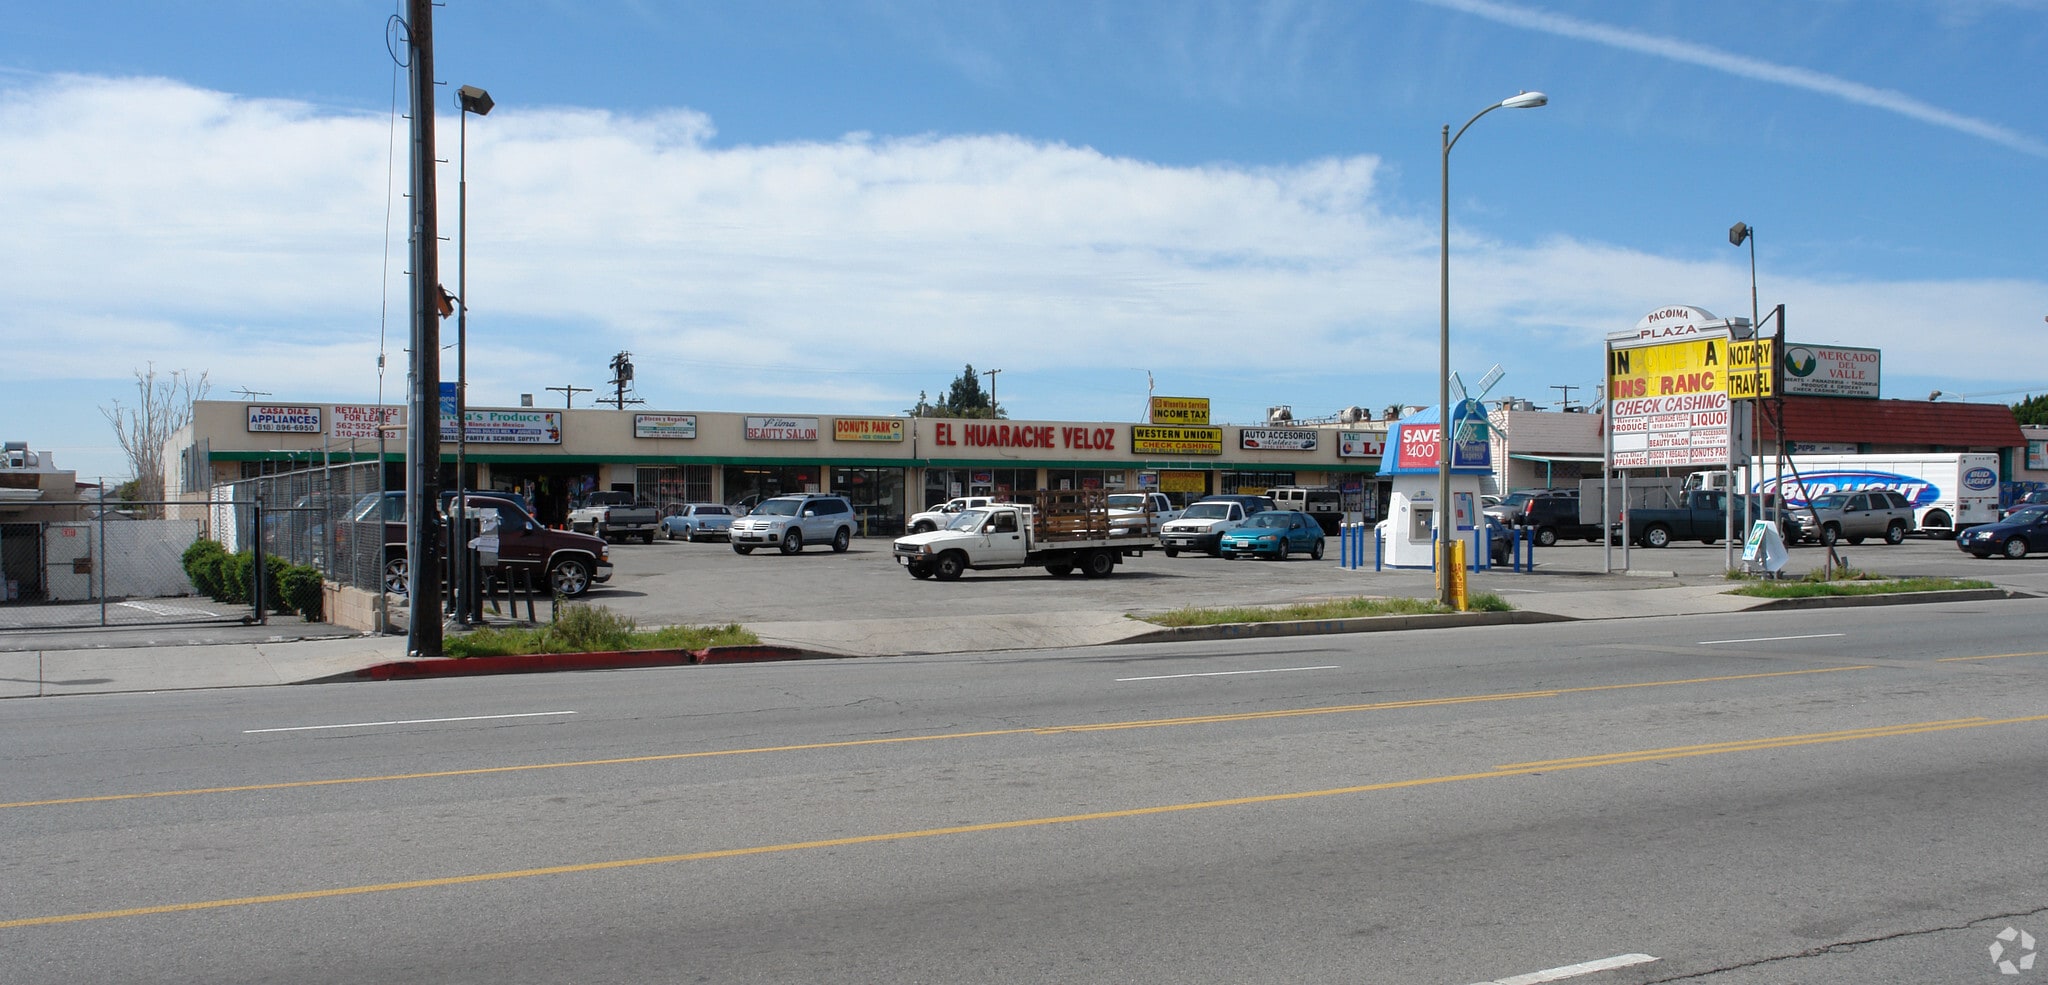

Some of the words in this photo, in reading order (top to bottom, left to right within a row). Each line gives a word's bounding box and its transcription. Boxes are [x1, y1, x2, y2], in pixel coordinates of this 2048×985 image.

[1648, 309, 1689, 323] PACOIMA
[1640, 325, 1697, 339] PLAZA
[1730, 344, 1770, 365] NOTARY
[1818, 351, 1877, 363] MERCADO
[1830, 369, 1865, 379] VALLE
[1730, 373, 1770, 395] TRAVEL
[335, 406, 367, 414] RETAIL
[1615, 398, 1662, 416] CHECK
[1664, 393, 1726, 412] CASHING
[251, 415, 318, 424] APPLIANCES
[363, 414, 391, 422] LEAE
[489, 412, 541, 422] Produce
[1154, 409, 1189, 418] INCOME
[1191, 411, 1207, 419] TAX
[763, 417, 797, 427] Vilma
[837, 420, 869, 433] DONUTS
[872, 421, 891, 433] PARK
[1611, 422, 1647, 432] PRODUCE
[748, 428, 784, 439] BEAUTY
[786, 428, 817, 439] SALON
[936, 423, 956, 446] EL
[964, 424, 1055, 448] HUARACHE
[1062, 427, 1115, 450] VELOZ
[1136, 428, 1180, 439] WESTERN
[1183, 430, 1213, 440] UNION
[1245, 431, 1266, 439] AUTO
[1268, 431, 1316, 440] ACCESORIOS
[1403, 428, 1441, 443] SAVE
[1649, 439, 1671, 448] BEAUTY
[1671, 437, 1689, 446] SALON
[1690, 447, 1714, 458] DONUTS
[1781, 483, 1837, 501] BUD
